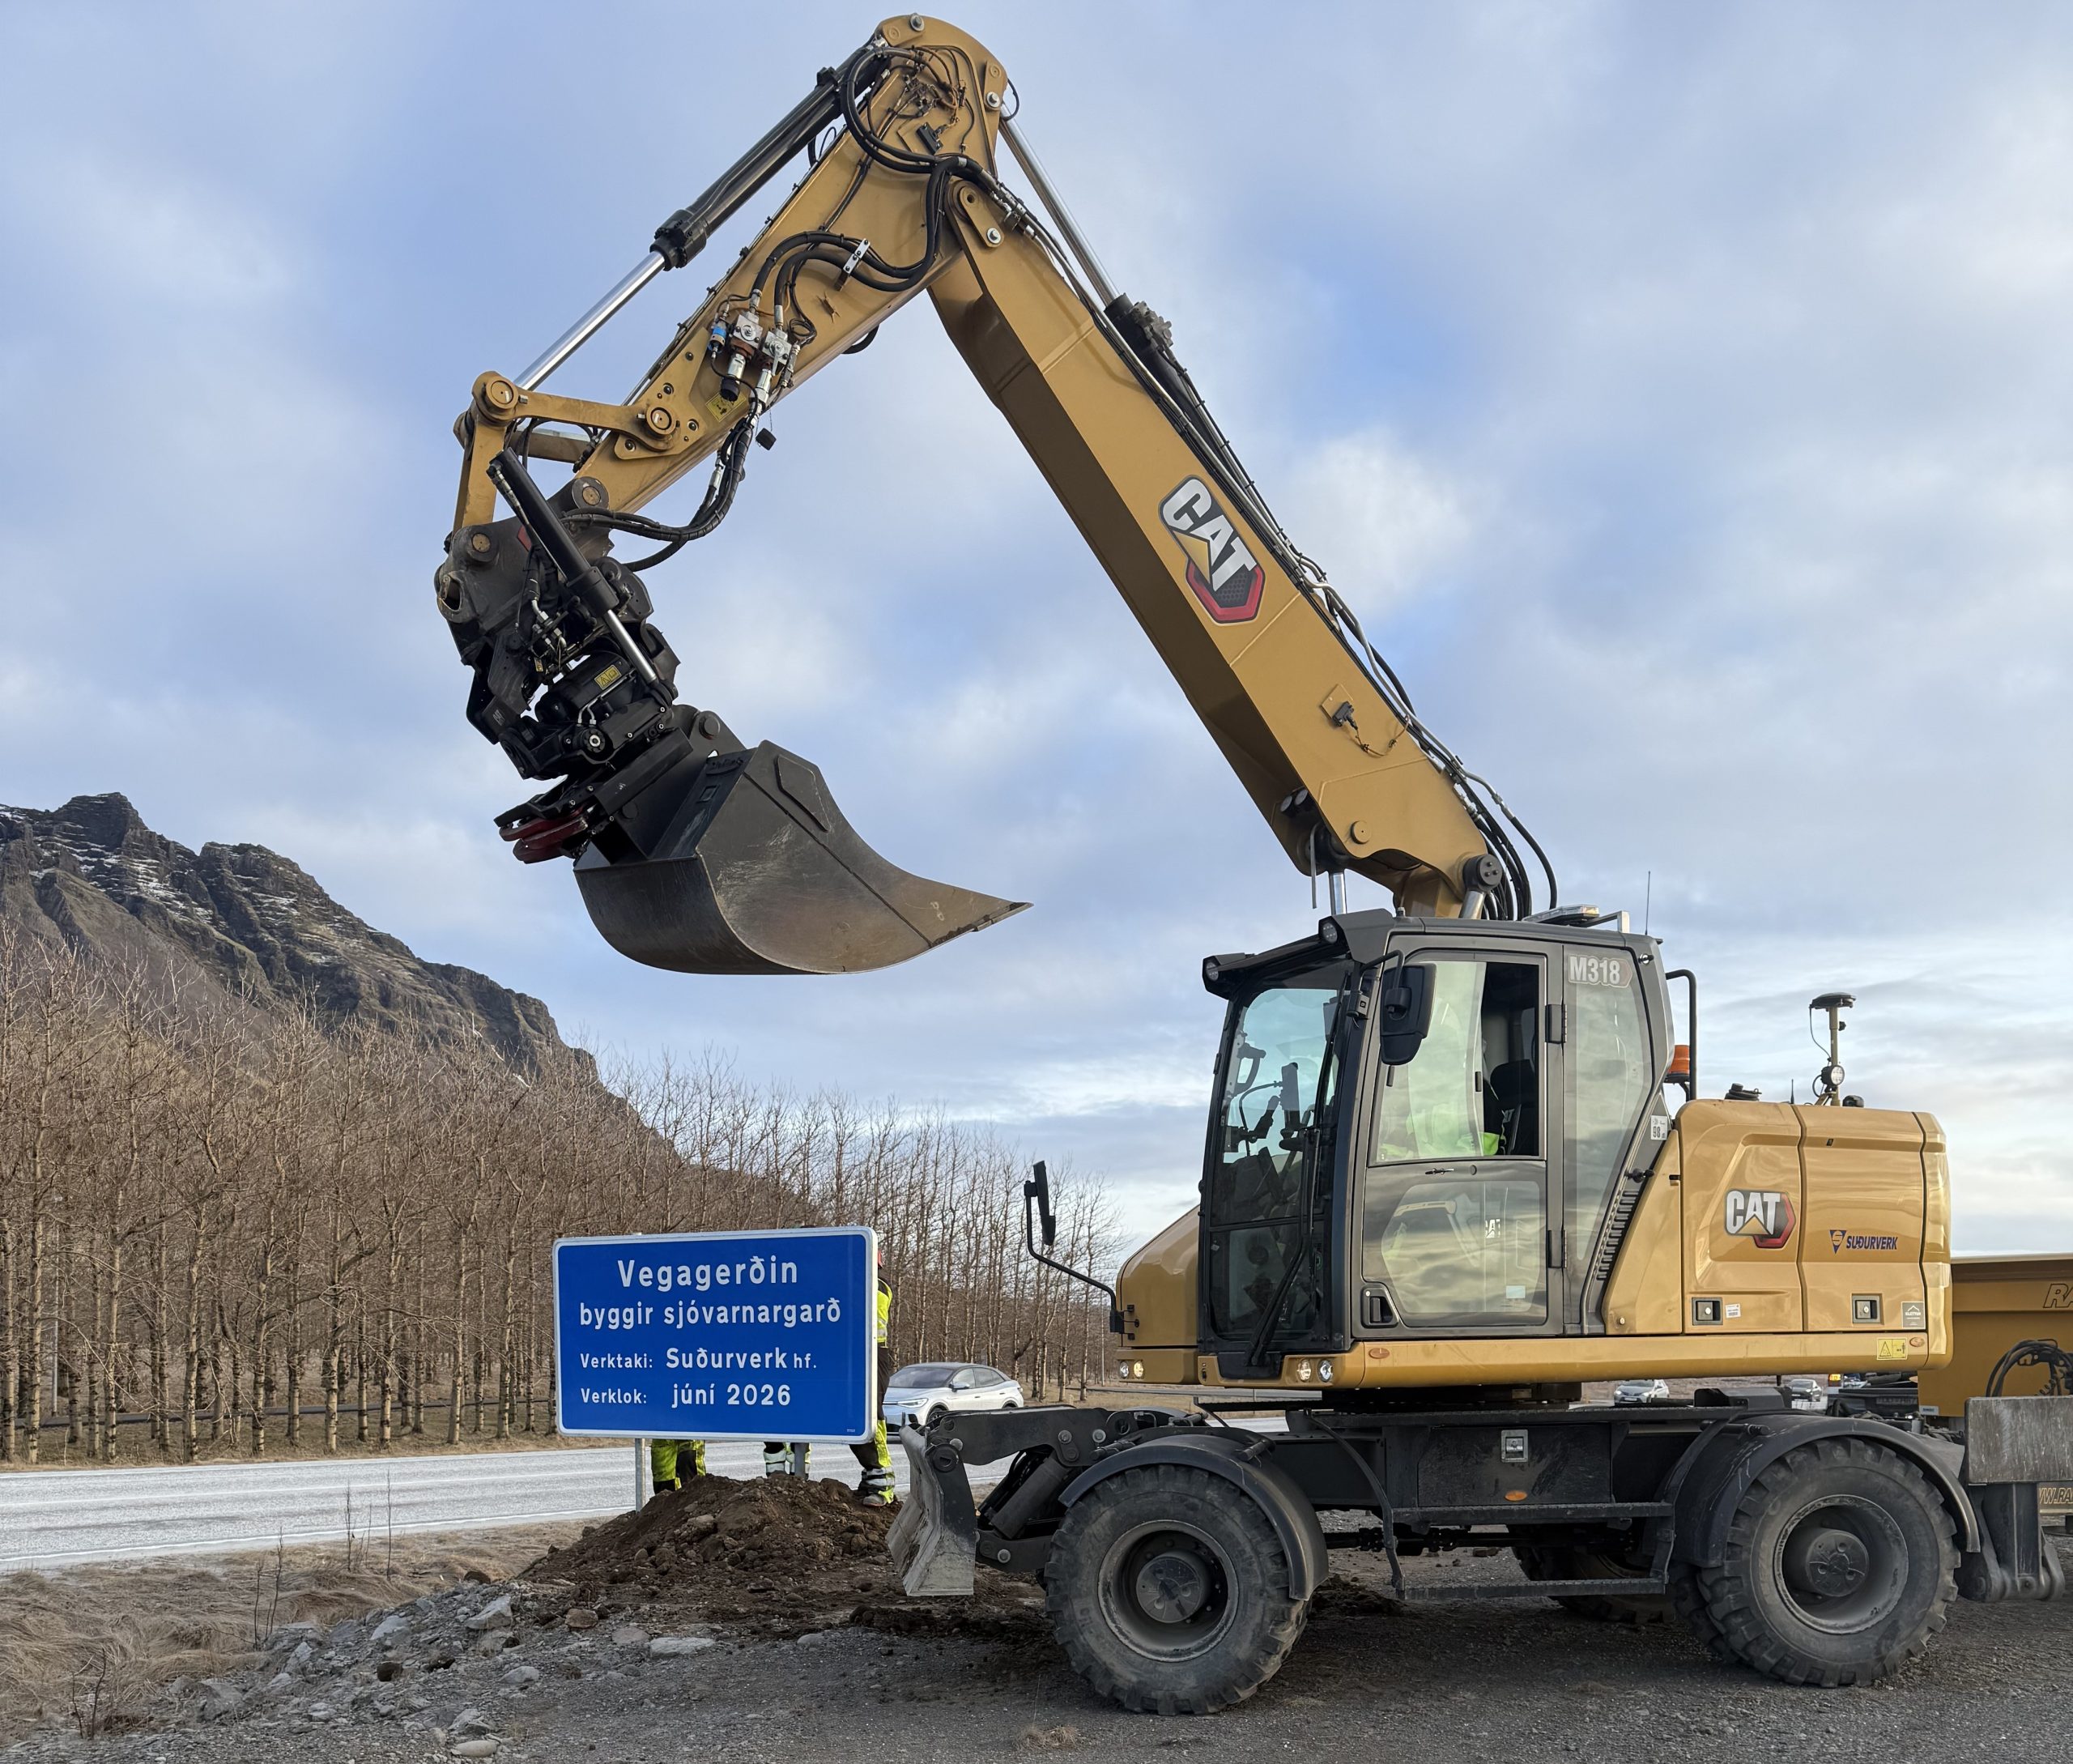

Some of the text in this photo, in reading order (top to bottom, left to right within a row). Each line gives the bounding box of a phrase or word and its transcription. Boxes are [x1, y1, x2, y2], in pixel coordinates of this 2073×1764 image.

[1162, 479, 1258, 592] CAT
[1569, 956, 1621, 985] M318
[1726, 1191, 1781, 1235] CAT
[617, 1255, 797, 1292] Vegagerðin
[580, 1297, 841, 1330] byggir sjóvarnargarð
[580, 1347, 817, 1369] Verktaki: Suðurverk hf.
[581, 1383, 790, 1408] Verklok: júní 2026
